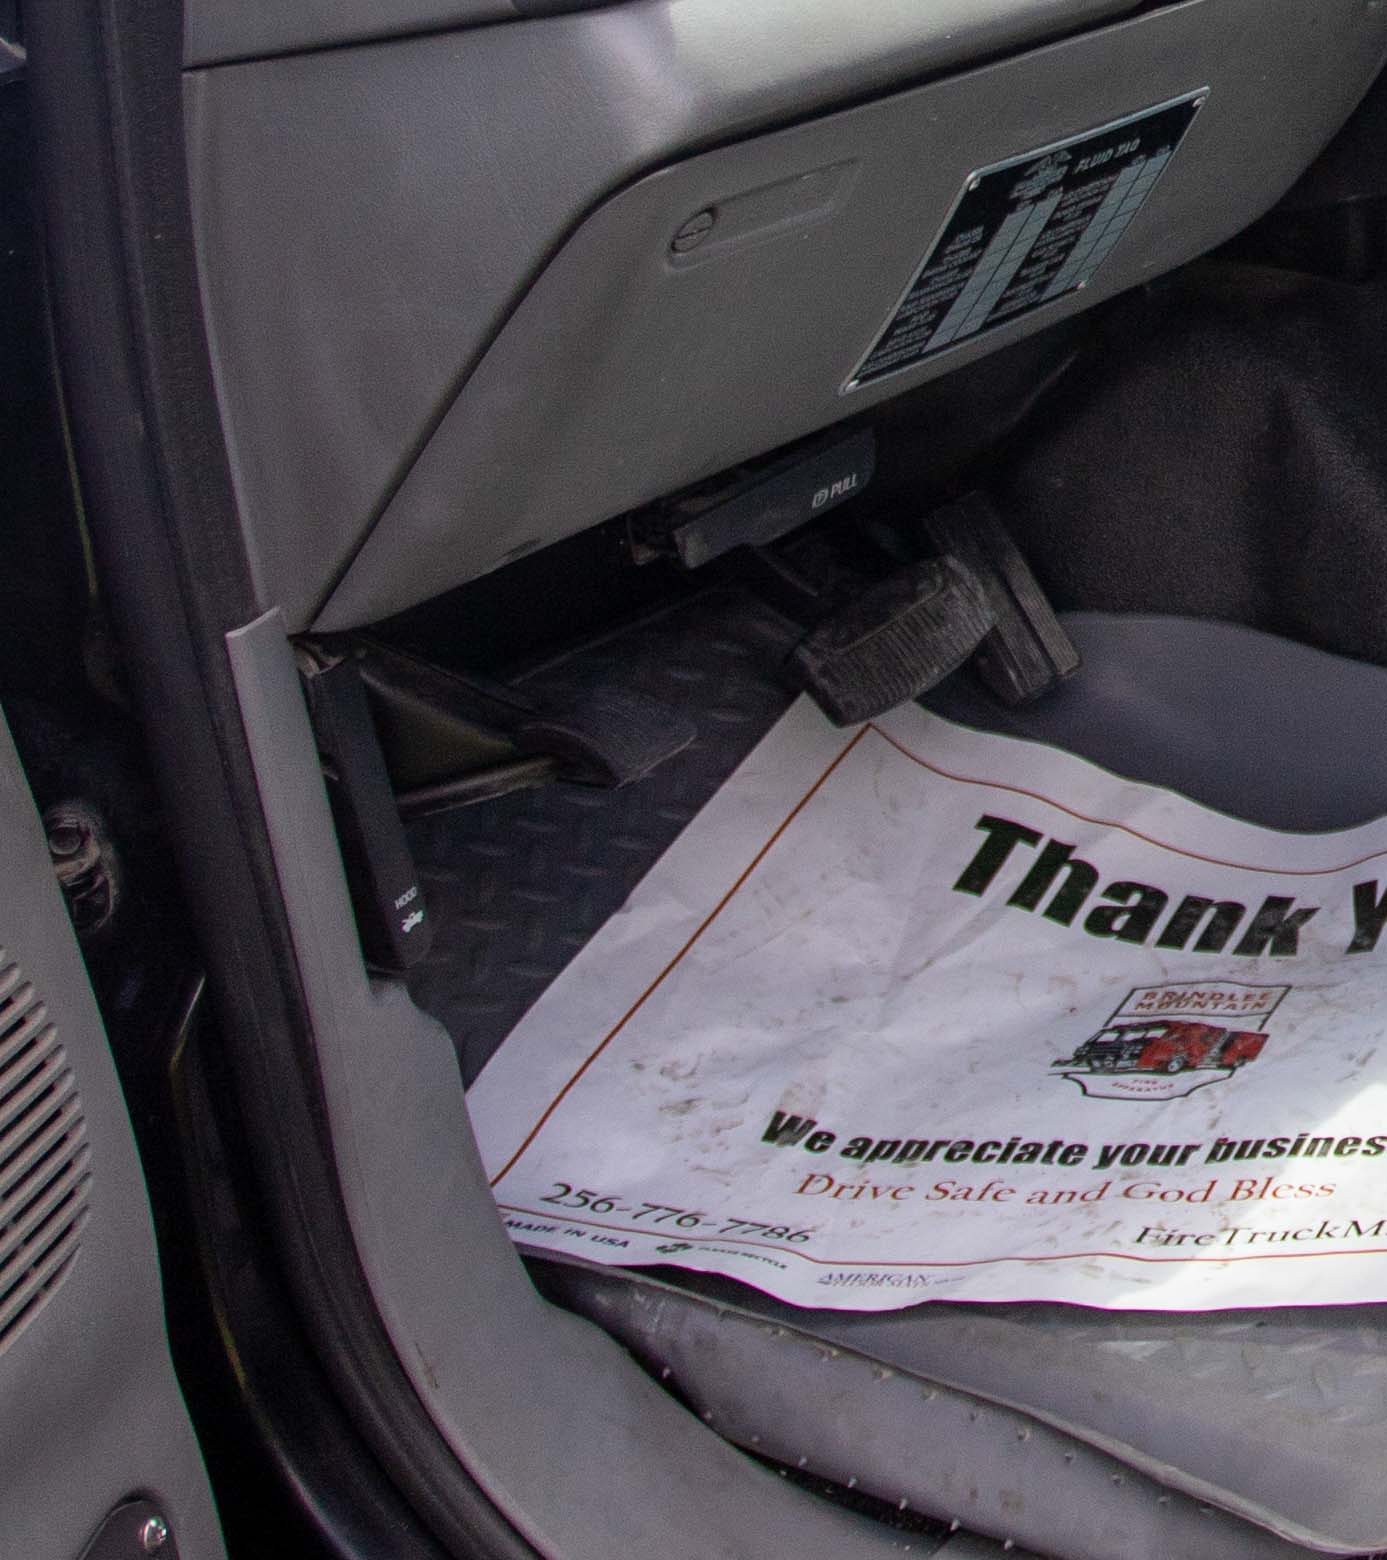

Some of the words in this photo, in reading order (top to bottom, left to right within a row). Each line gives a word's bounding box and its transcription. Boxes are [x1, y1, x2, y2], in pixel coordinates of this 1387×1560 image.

[1073, 148, 1114, 175] FLUID
[1115, 138, 1142, 159] TAG
[831, 473, 858, 499] PULL
[395, 886, 417, 910] HOOD
[952, 813, 1321, 958] Thank
[1134, 1000, 1267, 1011] MOUNTAIN
[1142, 990, 1274, 1002] BRINDLEE
[761, 1110, 835, 1155] We
[841, 1131, 1086, 1168] appreciate
[1092, 1143, 1203, 1170] your
[796, 1173, 915, 1201] Drive
[925, 1179, 1015, 1204] Safe
[1025, 1180, 1109, 1206] and
[1122, 1179, 1216, 1204] God
[1228, 1177, 1337, 1203] Bless
[538, 1182, 817, 1245] 256-776-7786
[504, 1220, 559, 1233] MADE
[564, 1229, 587, 1238] IN
[590, 1235, 631, 1248] USA
